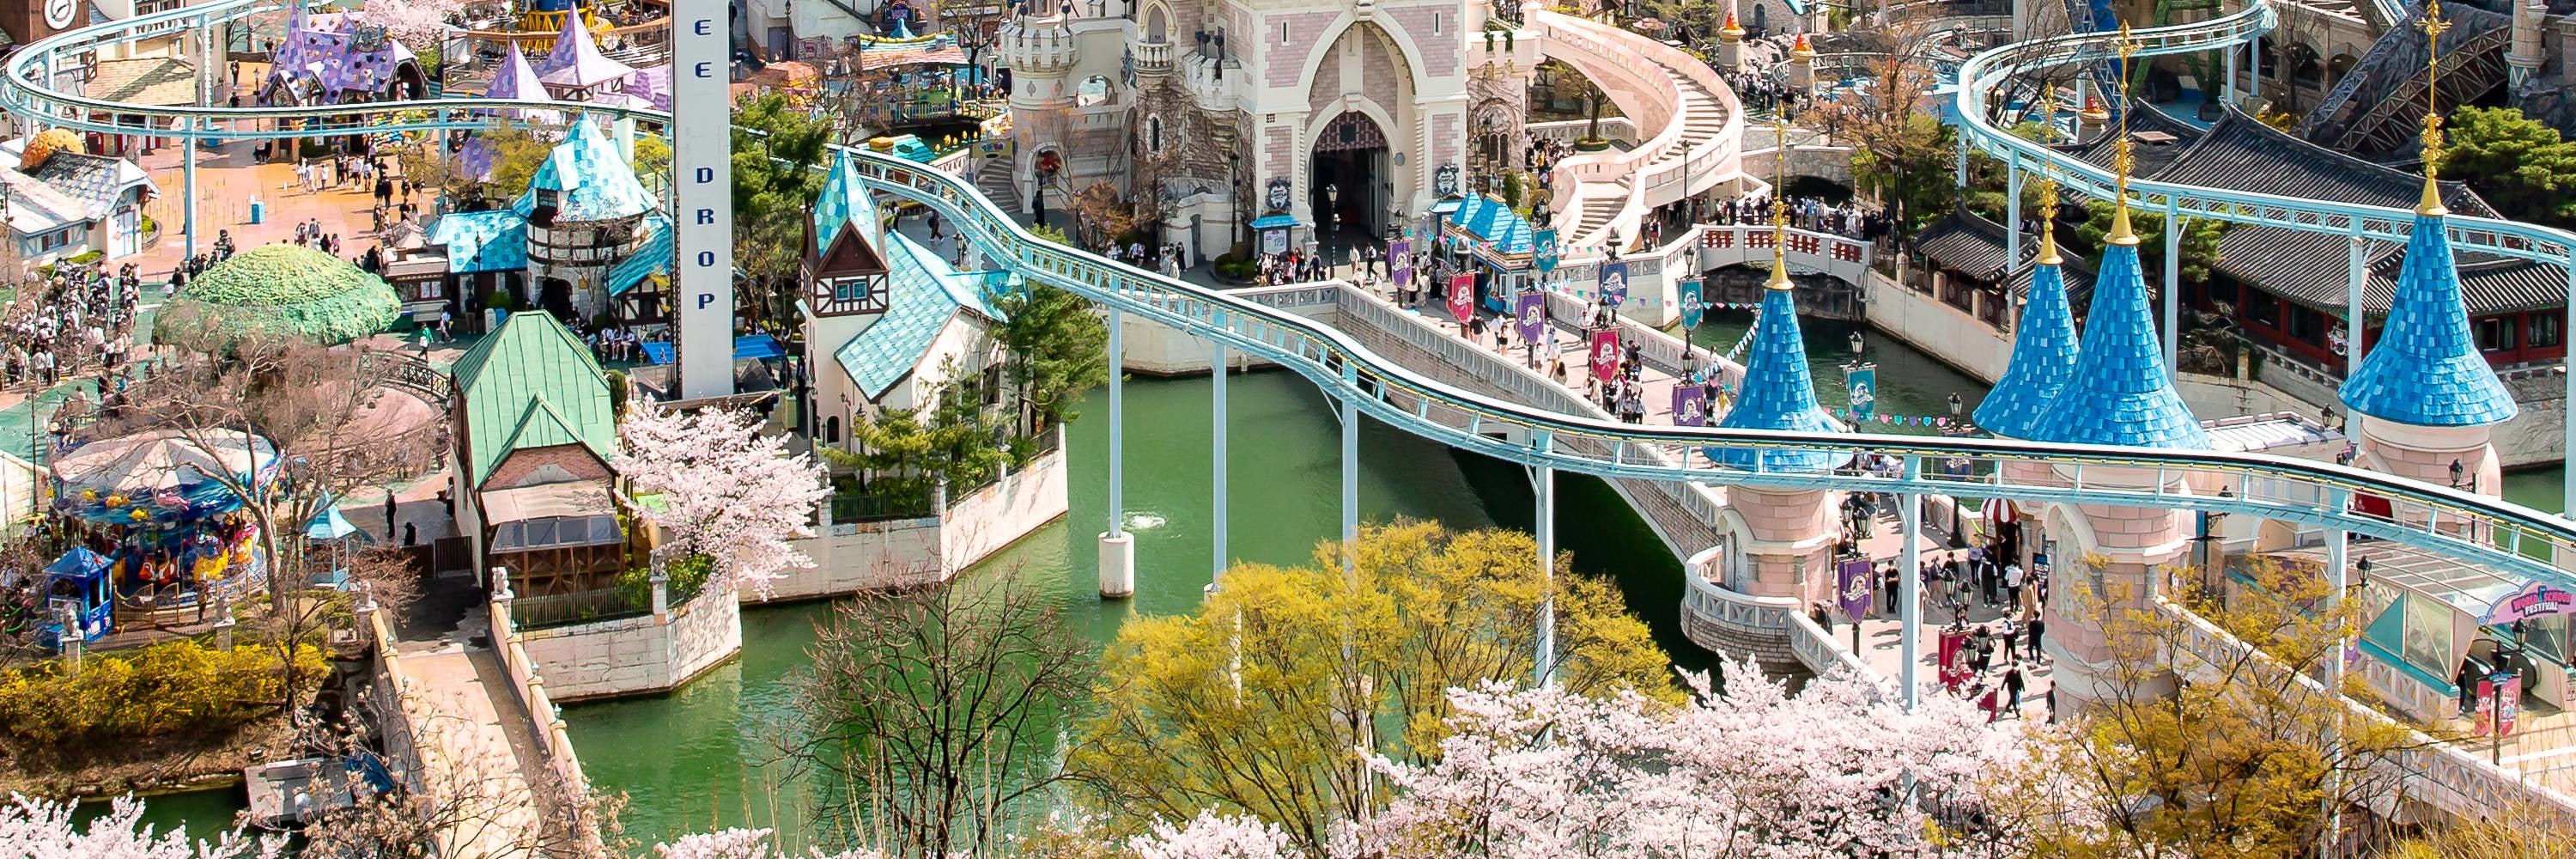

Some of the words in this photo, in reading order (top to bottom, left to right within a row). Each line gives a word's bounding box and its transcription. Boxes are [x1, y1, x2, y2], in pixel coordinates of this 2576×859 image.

[696, 167, 715, 310] DROP
[2543, 591, 2571, 603] SCHOOL
[2524, 601, 2558, 615] FESTIVAL
